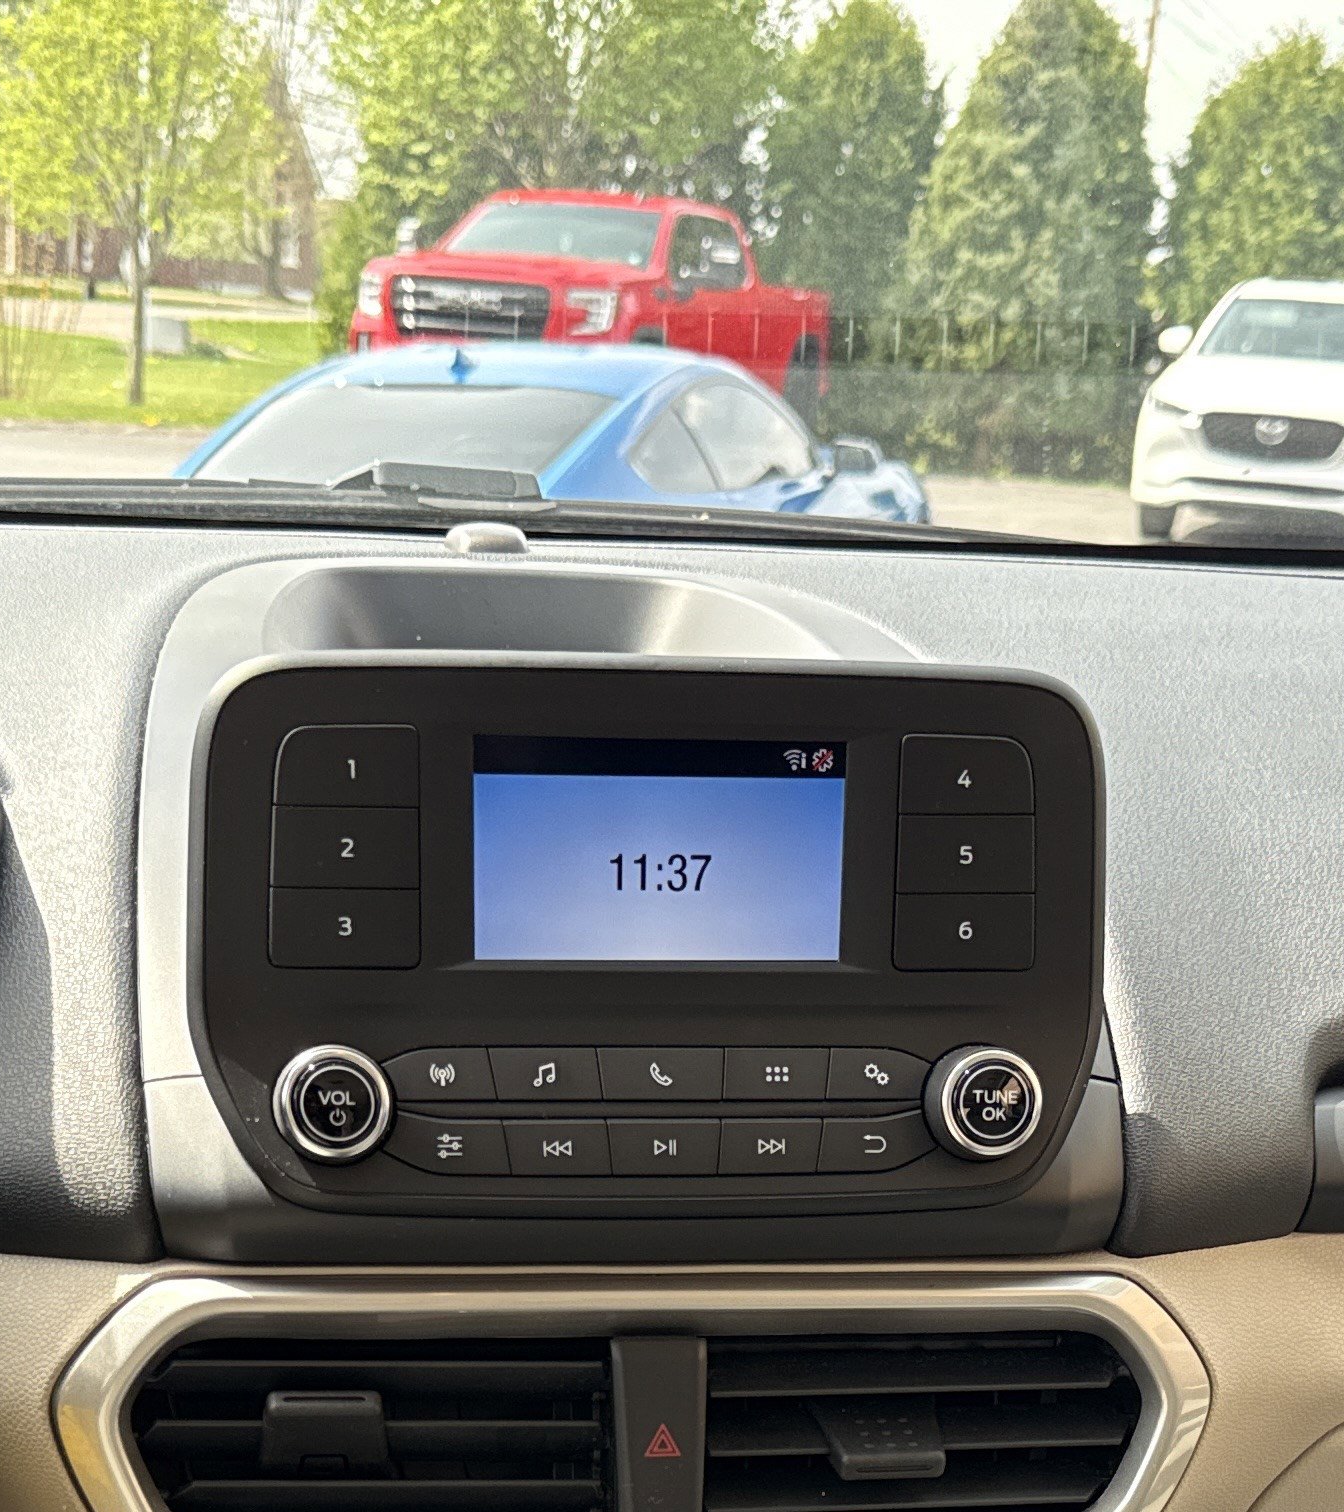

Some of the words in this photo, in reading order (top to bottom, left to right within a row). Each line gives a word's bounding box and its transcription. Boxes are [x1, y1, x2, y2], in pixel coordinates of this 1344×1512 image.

[347, 758, 356, 779] 1
[957, 770, 973, 788] 4
[340, 838, 355, 858] 2
[959, 846, 974, 865] 5
[610, 853, 712, 892] 11:37
[338, 916, 353, 936] 3
[958, 921, 973, 940] 6
[318, 1090, 356, 1106] VOL
[972, 1089, 1019, 1105] TUNE
[981, 1106, 1007, 1122] OK
